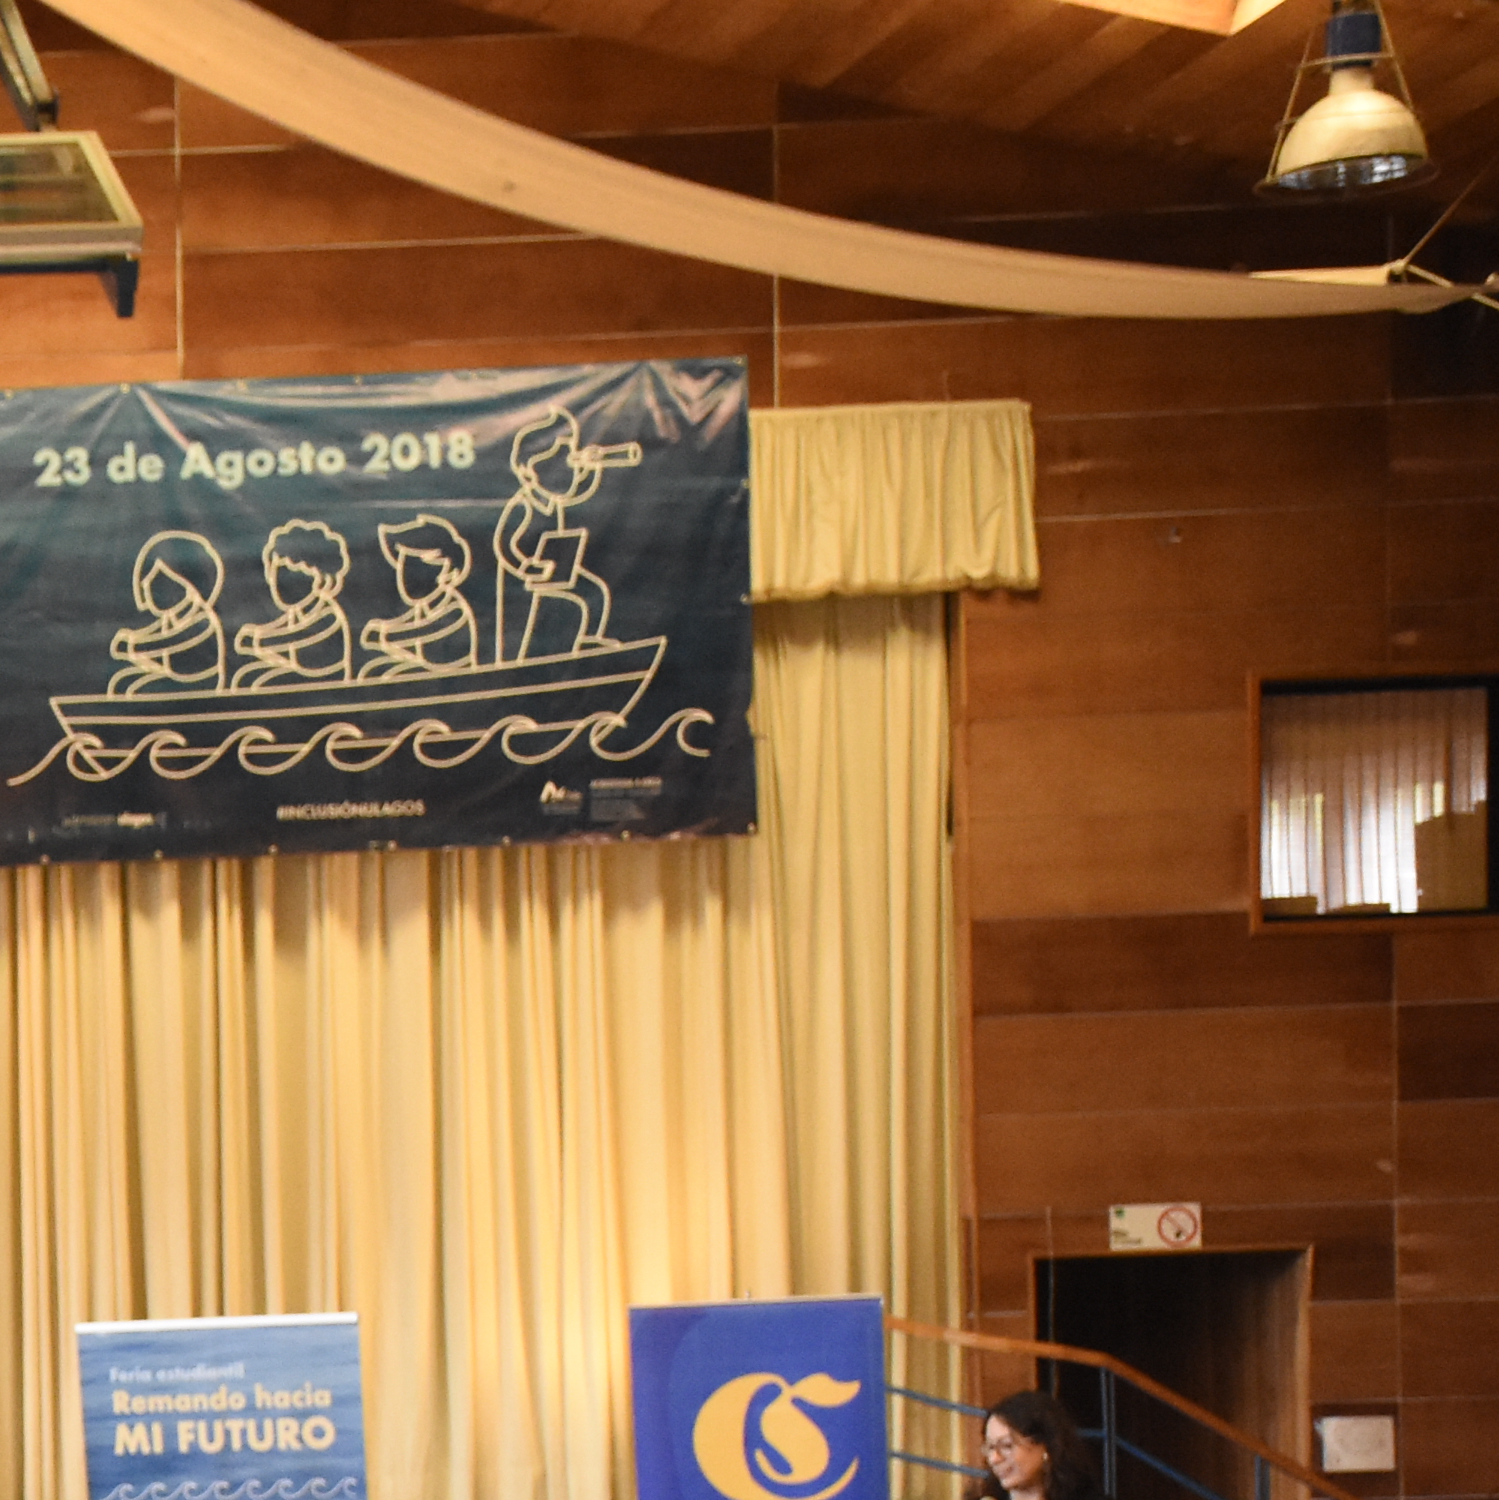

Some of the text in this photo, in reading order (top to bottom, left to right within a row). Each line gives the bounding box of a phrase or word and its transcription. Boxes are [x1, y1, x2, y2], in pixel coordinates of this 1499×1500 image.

[32, 428, 477, 491] 23 de Agosto 2018
[109, 1362, 246, 1383] Feria estudiantil
[111, 1380, 333, 1416] Remando hacia
[113, 1414, 337, 1457] MI FUTURO
